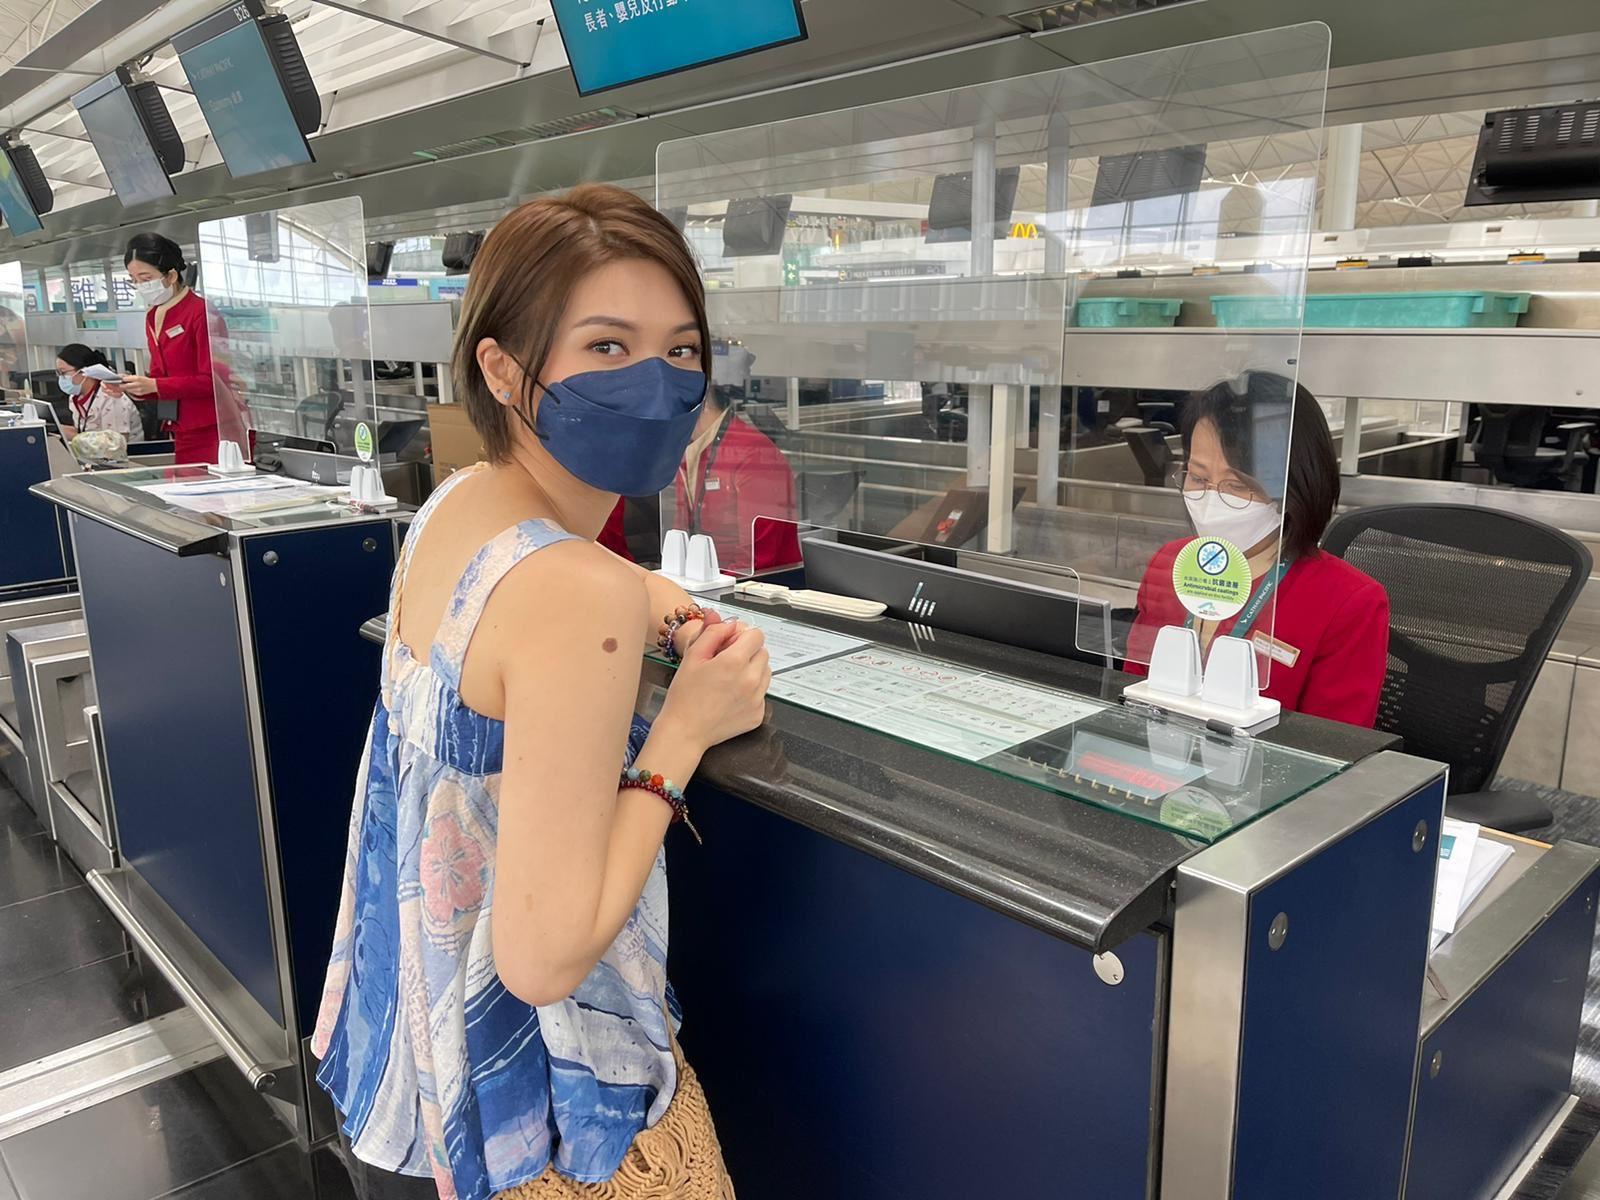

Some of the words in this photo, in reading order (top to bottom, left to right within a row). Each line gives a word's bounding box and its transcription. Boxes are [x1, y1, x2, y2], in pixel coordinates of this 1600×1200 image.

[584, 0, 688, 33] 長者、嬰兒及行
[1184, 582, 1217, 592] Antimicrobial
[1217, 587, 1239, 596] coatings
[1246, 598, 1262, 619] CATHAY
[1259, 581, 1274, 600] PACIFIC
